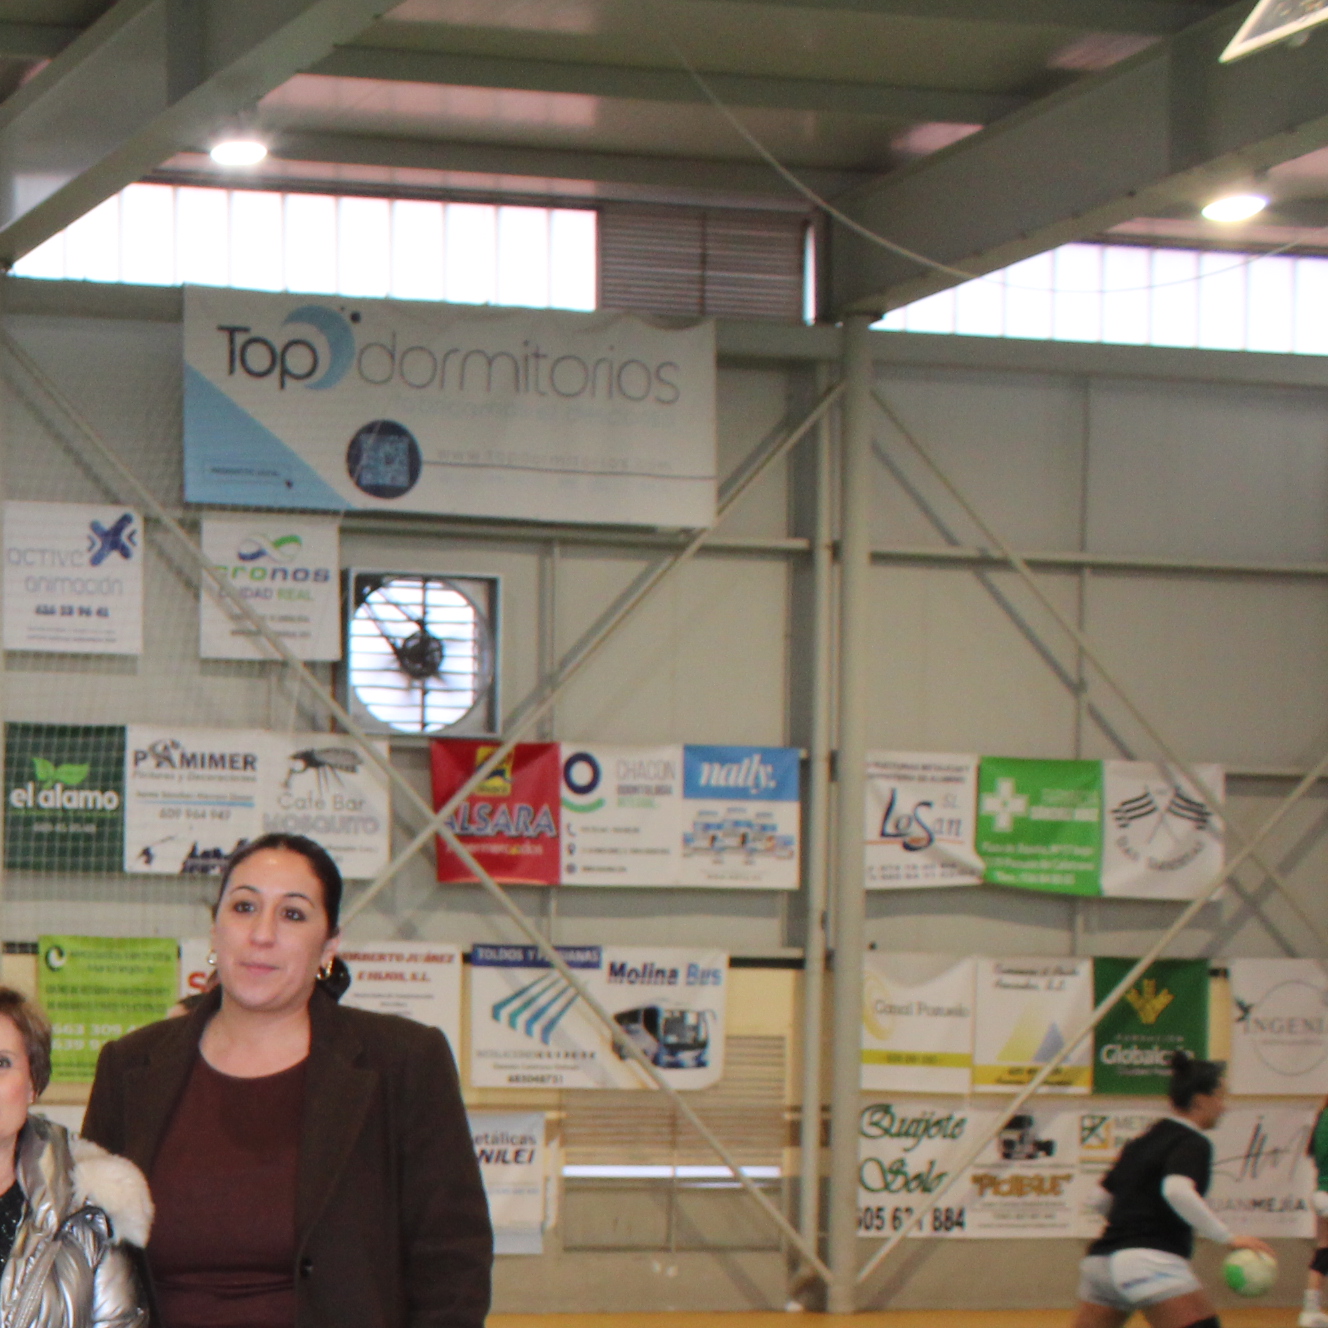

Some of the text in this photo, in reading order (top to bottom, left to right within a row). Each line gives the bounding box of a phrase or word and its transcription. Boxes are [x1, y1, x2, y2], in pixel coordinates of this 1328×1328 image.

[216, 324, 682, 405] Top dormitorios
[9, 780, 120, 811] el alamo
[608, 960, 723, 986] Molina Bus
[1100, 1043, 1196, 1067] Globalc
[474, 1130, 537, 1146] etálicas
[859, 1103, 968, 1152] Quijote
